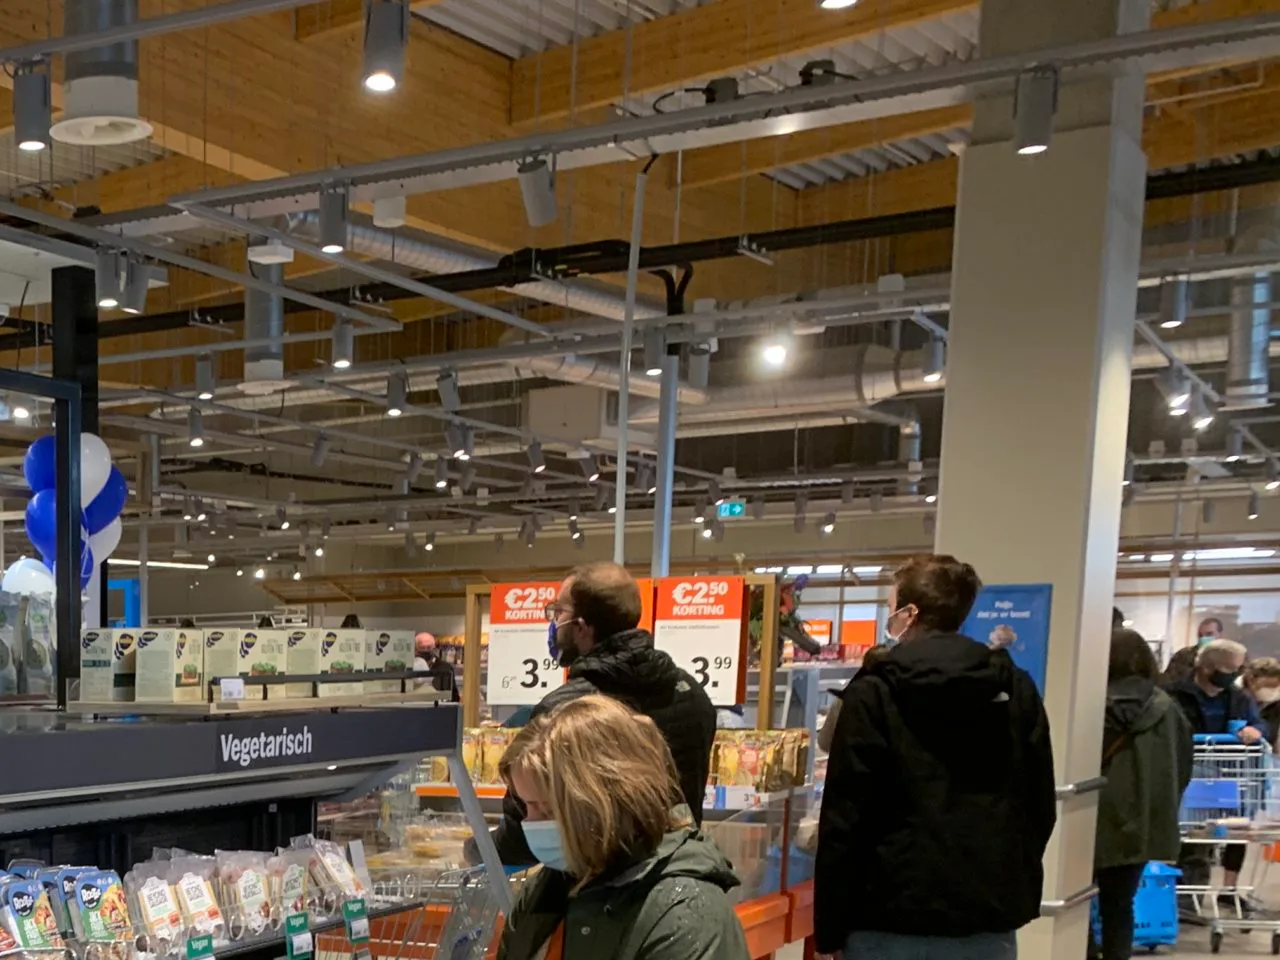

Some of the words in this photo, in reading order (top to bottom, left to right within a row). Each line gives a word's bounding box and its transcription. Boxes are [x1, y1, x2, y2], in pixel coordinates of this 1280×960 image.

[505, 586, 555, 609] €2.50
[672, 581, 729, 605] €2.50
[672, 604, 725, 616] KORTING
[520, 656, 559, 689] 3.99
[691, 656, 732, 689] 3.99
[220, 725, 313, 767] Vegetarisch
